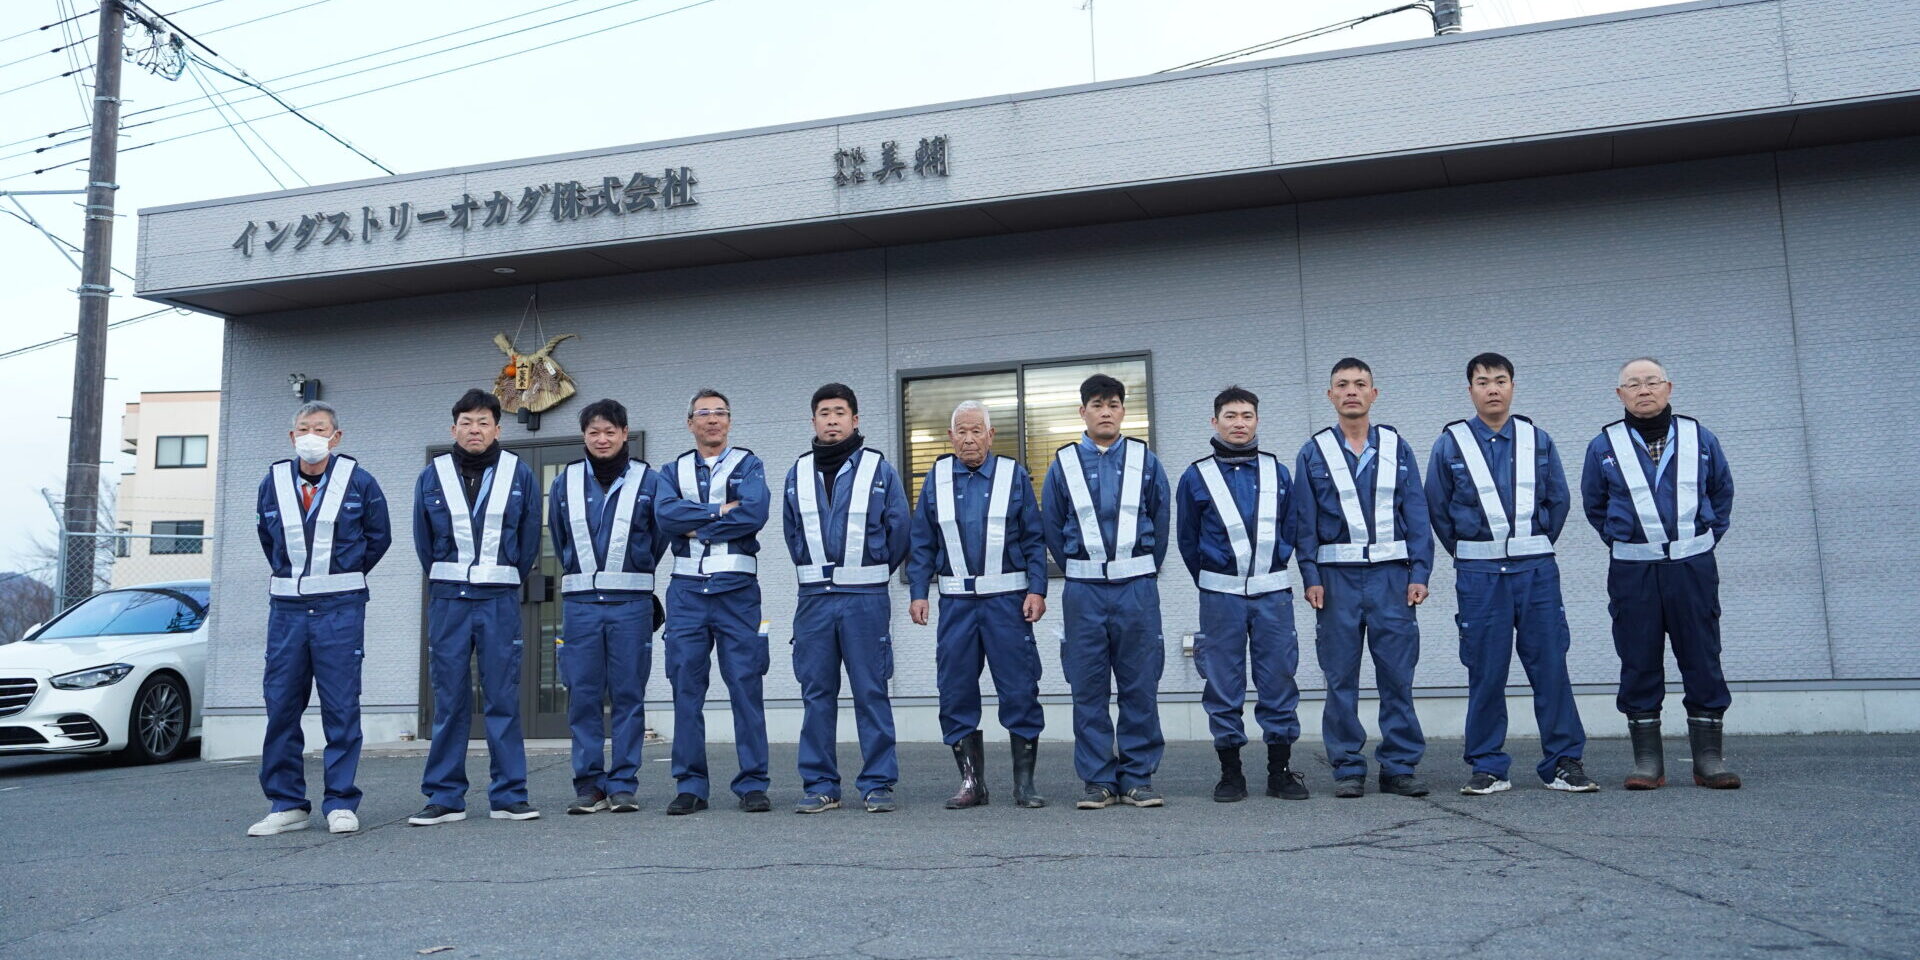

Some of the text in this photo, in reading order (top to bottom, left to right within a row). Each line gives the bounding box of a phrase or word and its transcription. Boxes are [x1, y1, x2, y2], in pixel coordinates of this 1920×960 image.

[232, 166, 698, 257] インダストリーオカダ株式会社
